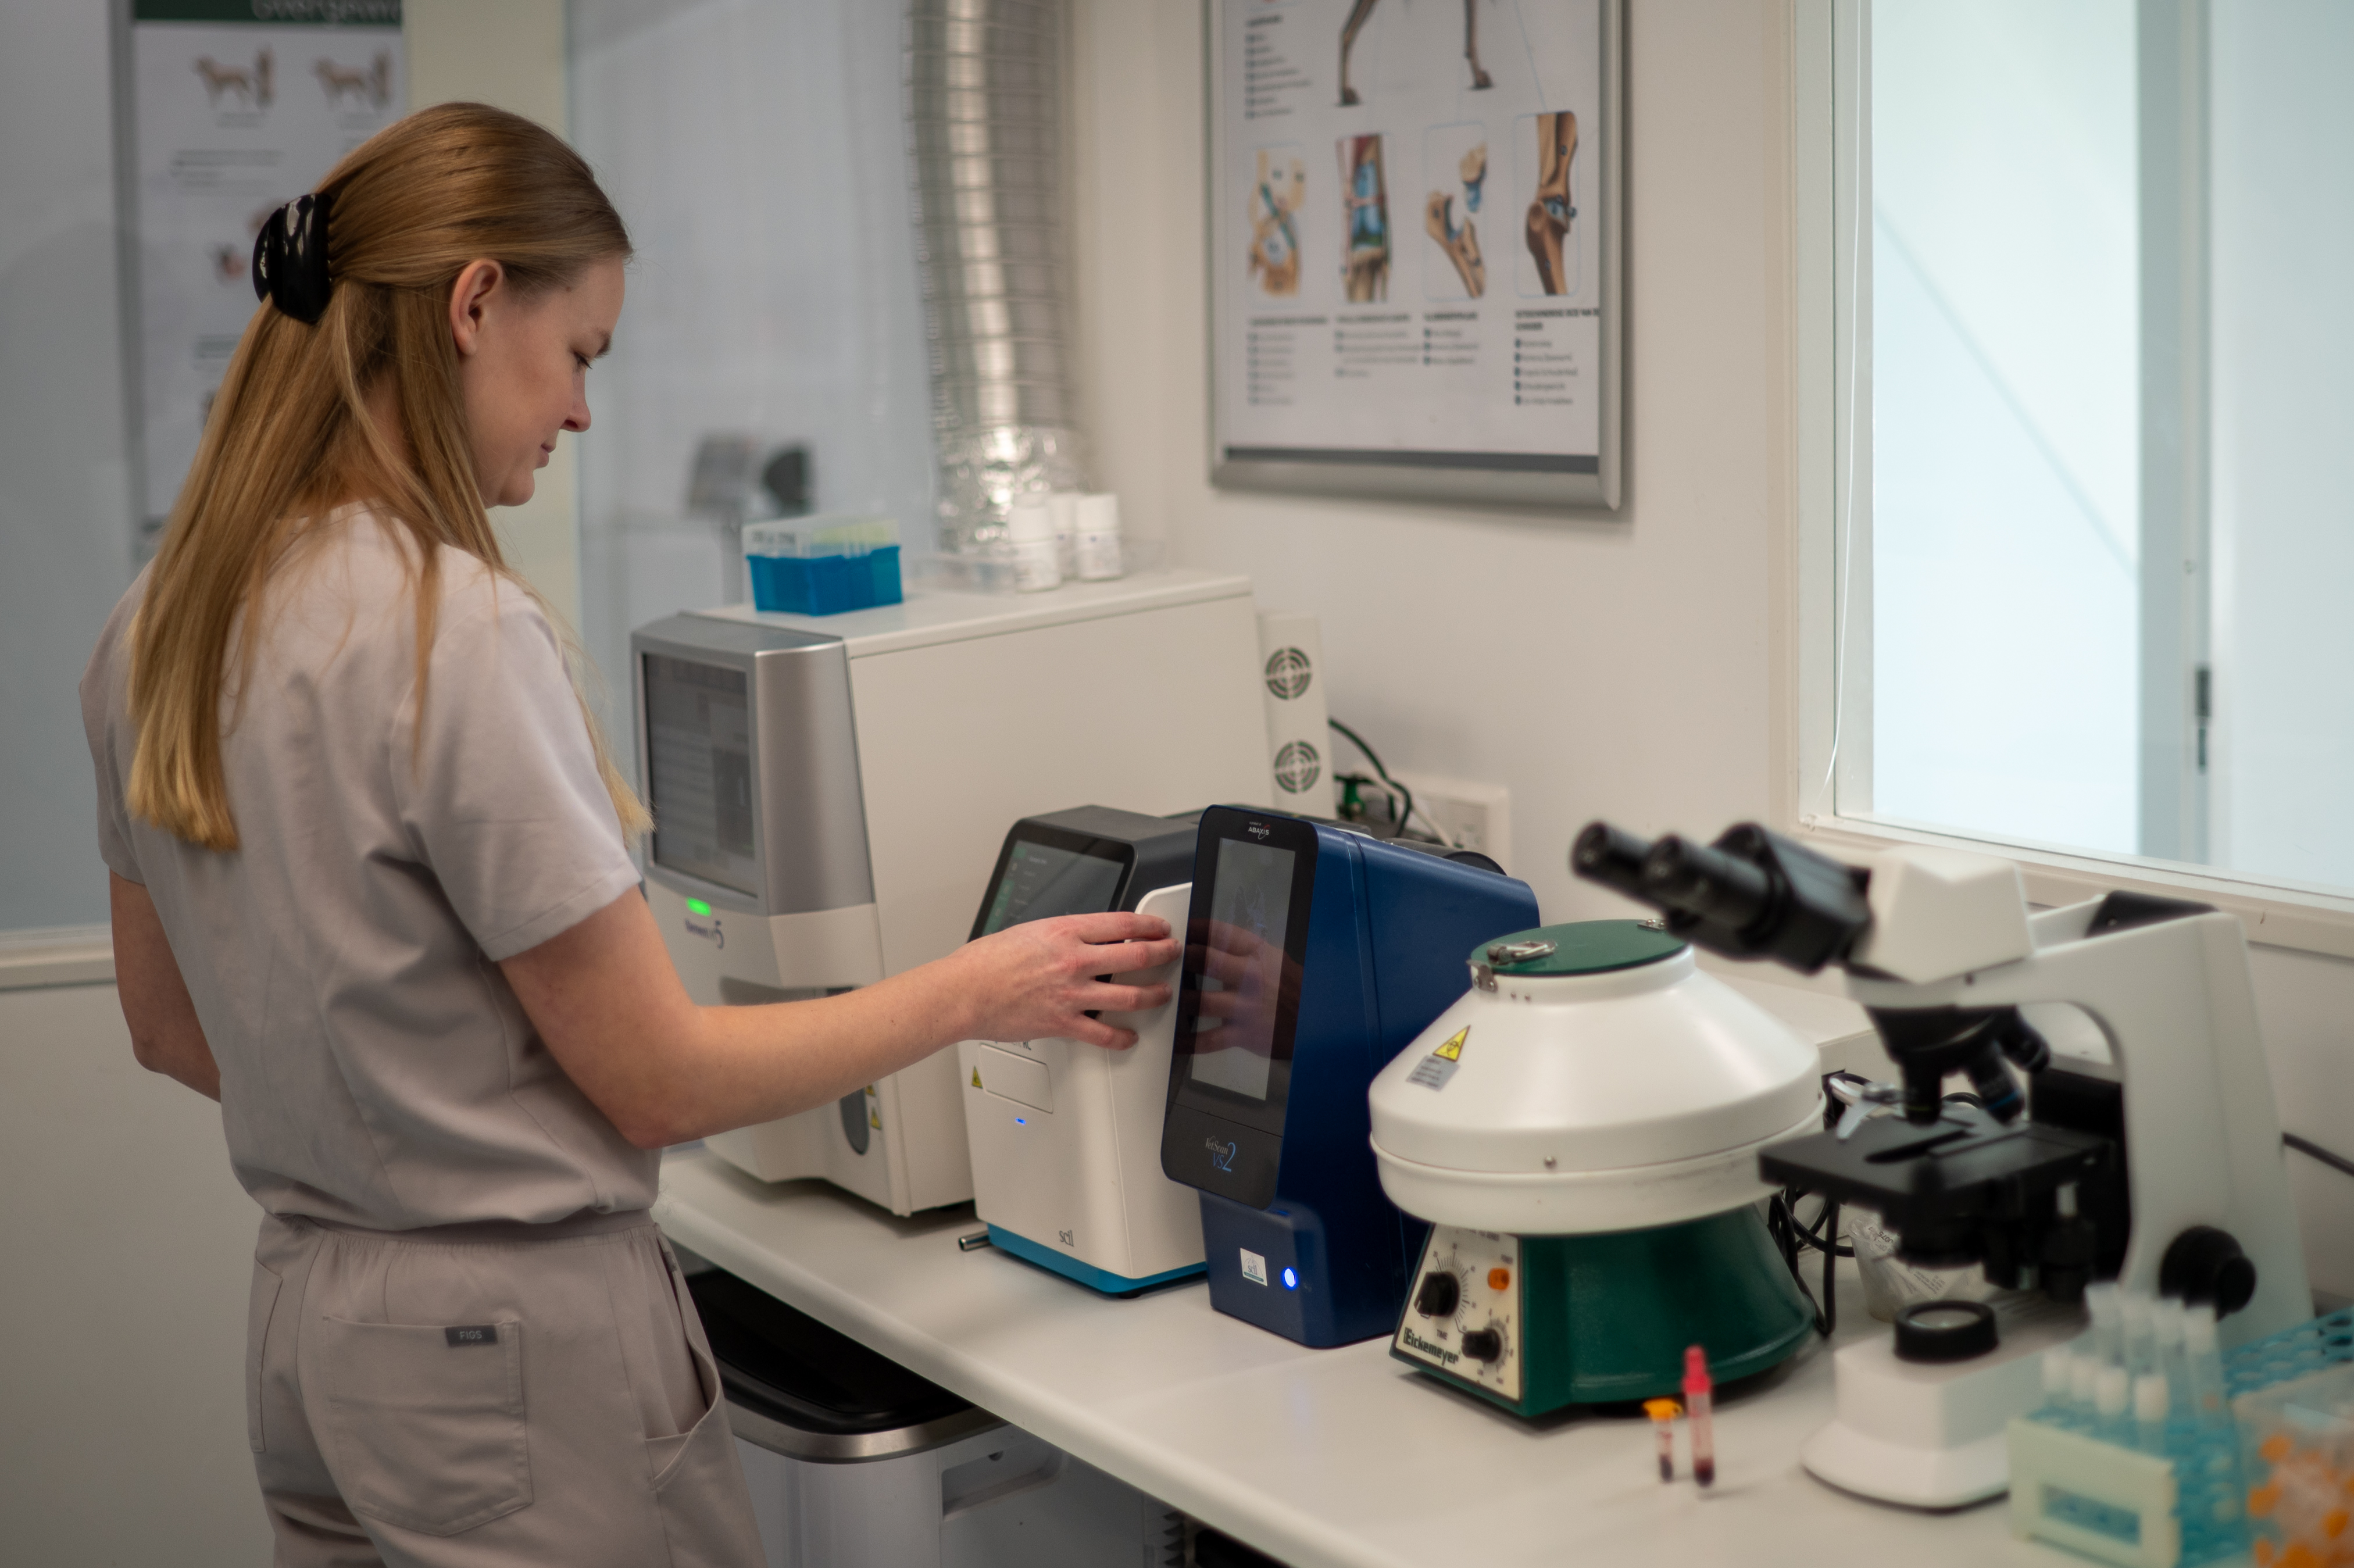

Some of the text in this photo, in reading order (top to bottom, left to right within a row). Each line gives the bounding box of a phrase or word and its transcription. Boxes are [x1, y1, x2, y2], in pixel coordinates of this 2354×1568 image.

[1248, 826, 1269, 835] ABAXIS
[1205, 1136, 1228, 1155] VetScan
[1059, 1230, 1074, 1247] scil
[460, 1330, 482, 1340] FIGS
[1403, 1327, 1459, 1366] Eickemeyer
